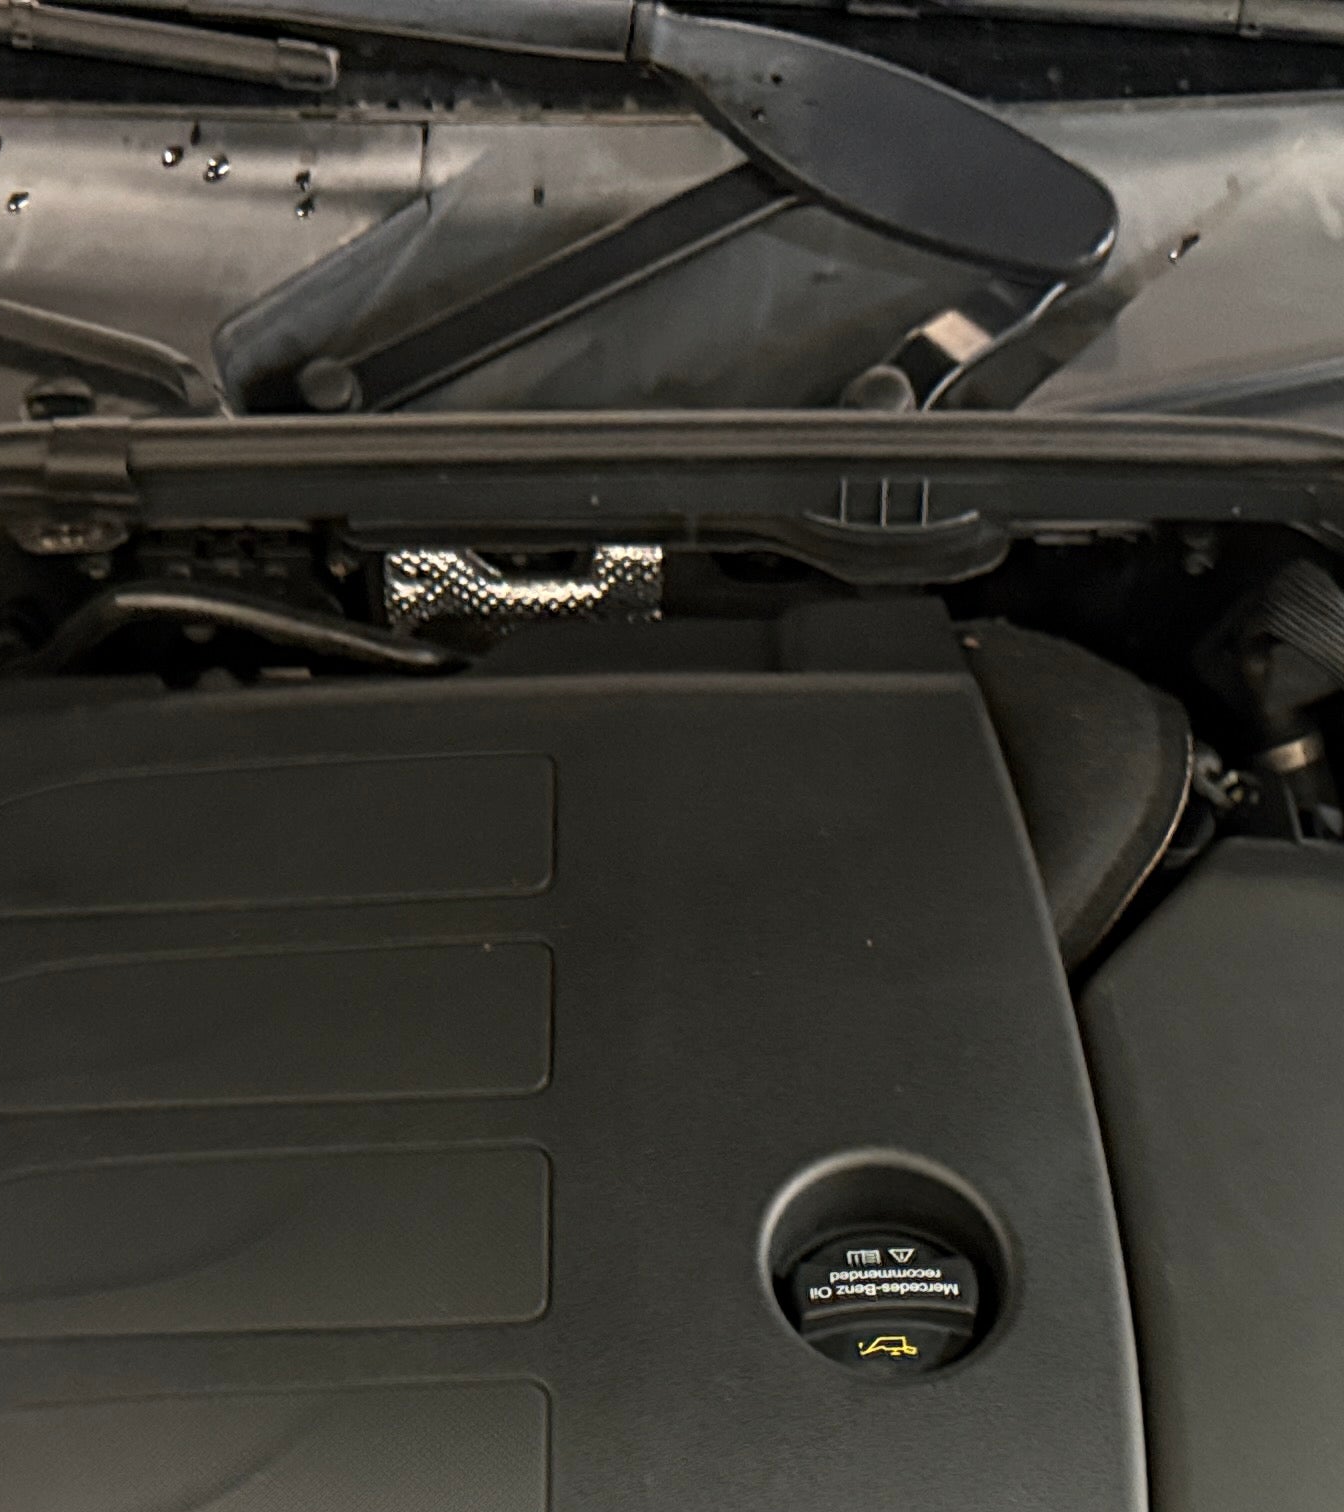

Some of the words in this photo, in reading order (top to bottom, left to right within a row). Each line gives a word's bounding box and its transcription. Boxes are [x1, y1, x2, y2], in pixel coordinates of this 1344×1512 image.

[830, 1269, 941, 1282] recommended
[809, 1286, 832, 1300] Oil
[835, 1282, 959, 1297] Mercedes-Benz
